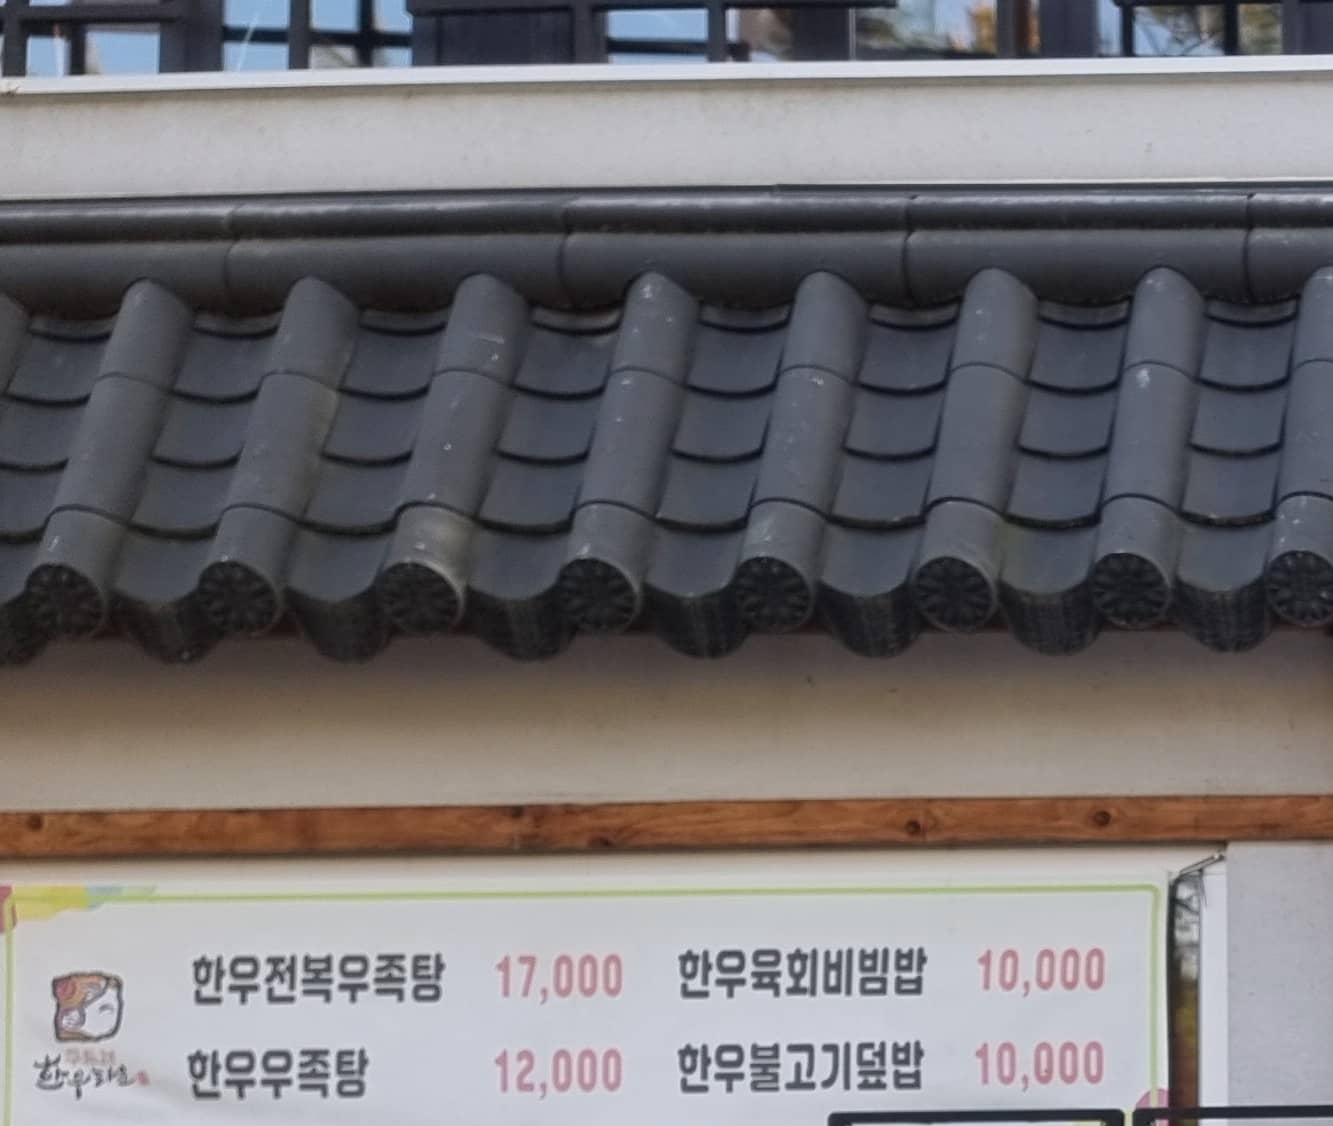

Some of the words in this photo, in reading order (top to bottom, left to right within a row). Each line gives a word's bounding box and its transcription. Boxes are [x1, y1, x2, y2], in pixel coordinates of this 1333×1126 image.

[192, 952, 446, 1005] 한우전복우족탕
[495, 954, 624, 1002] 17,000
[677, 947, 929, 1000] 한우육회비빔밥
[976, 948, 1107, 994] 10,000
[186, 1048, 369, 1100] 한우우족탕
[494, 1048, 624, 1096] 12,000
[677, 1040, 926, 1096] 한우불고기덮밥
[974, 1040, 1105, 1089] 10,000
